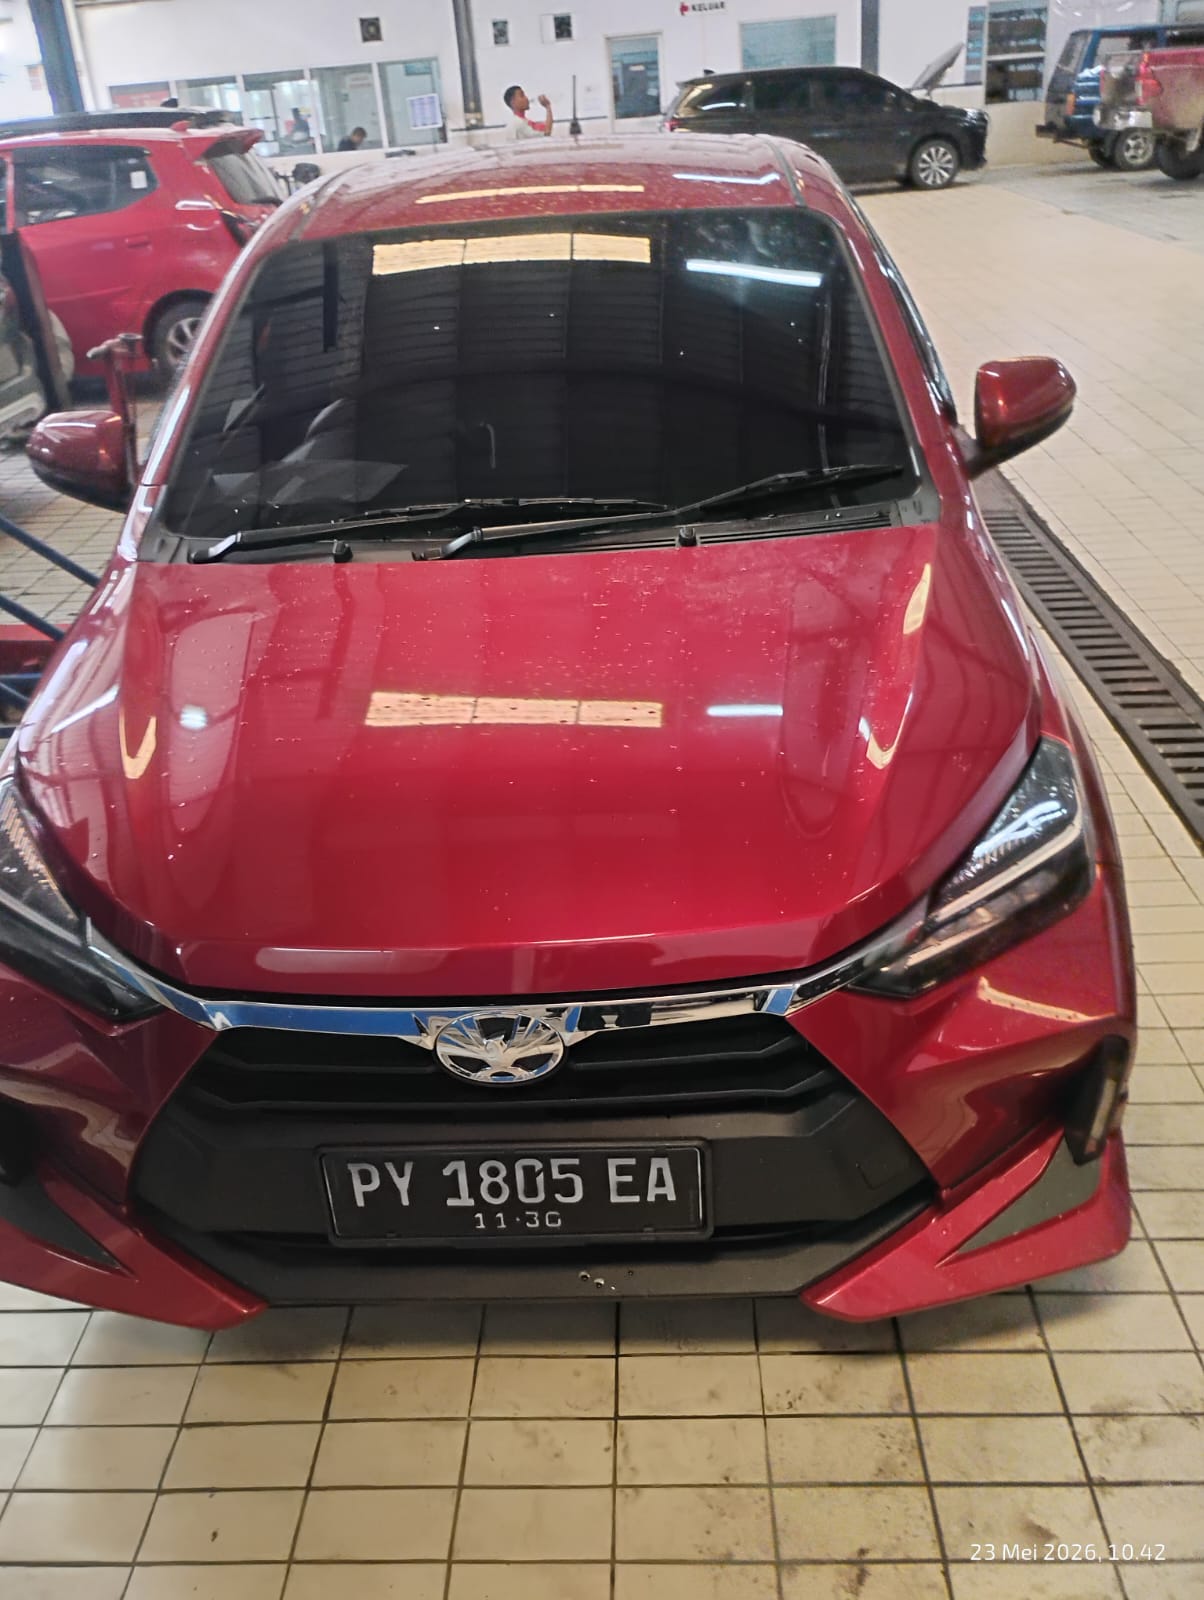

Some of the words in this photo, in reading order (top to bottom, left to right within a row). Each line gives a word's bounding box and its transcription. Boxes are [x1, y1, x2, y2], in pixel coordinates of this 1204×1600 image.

[346, 1160, 414, 1207] PY
[442, 1157, 584, 1207] 1805
[607, 1157, 676, 1204] EA
